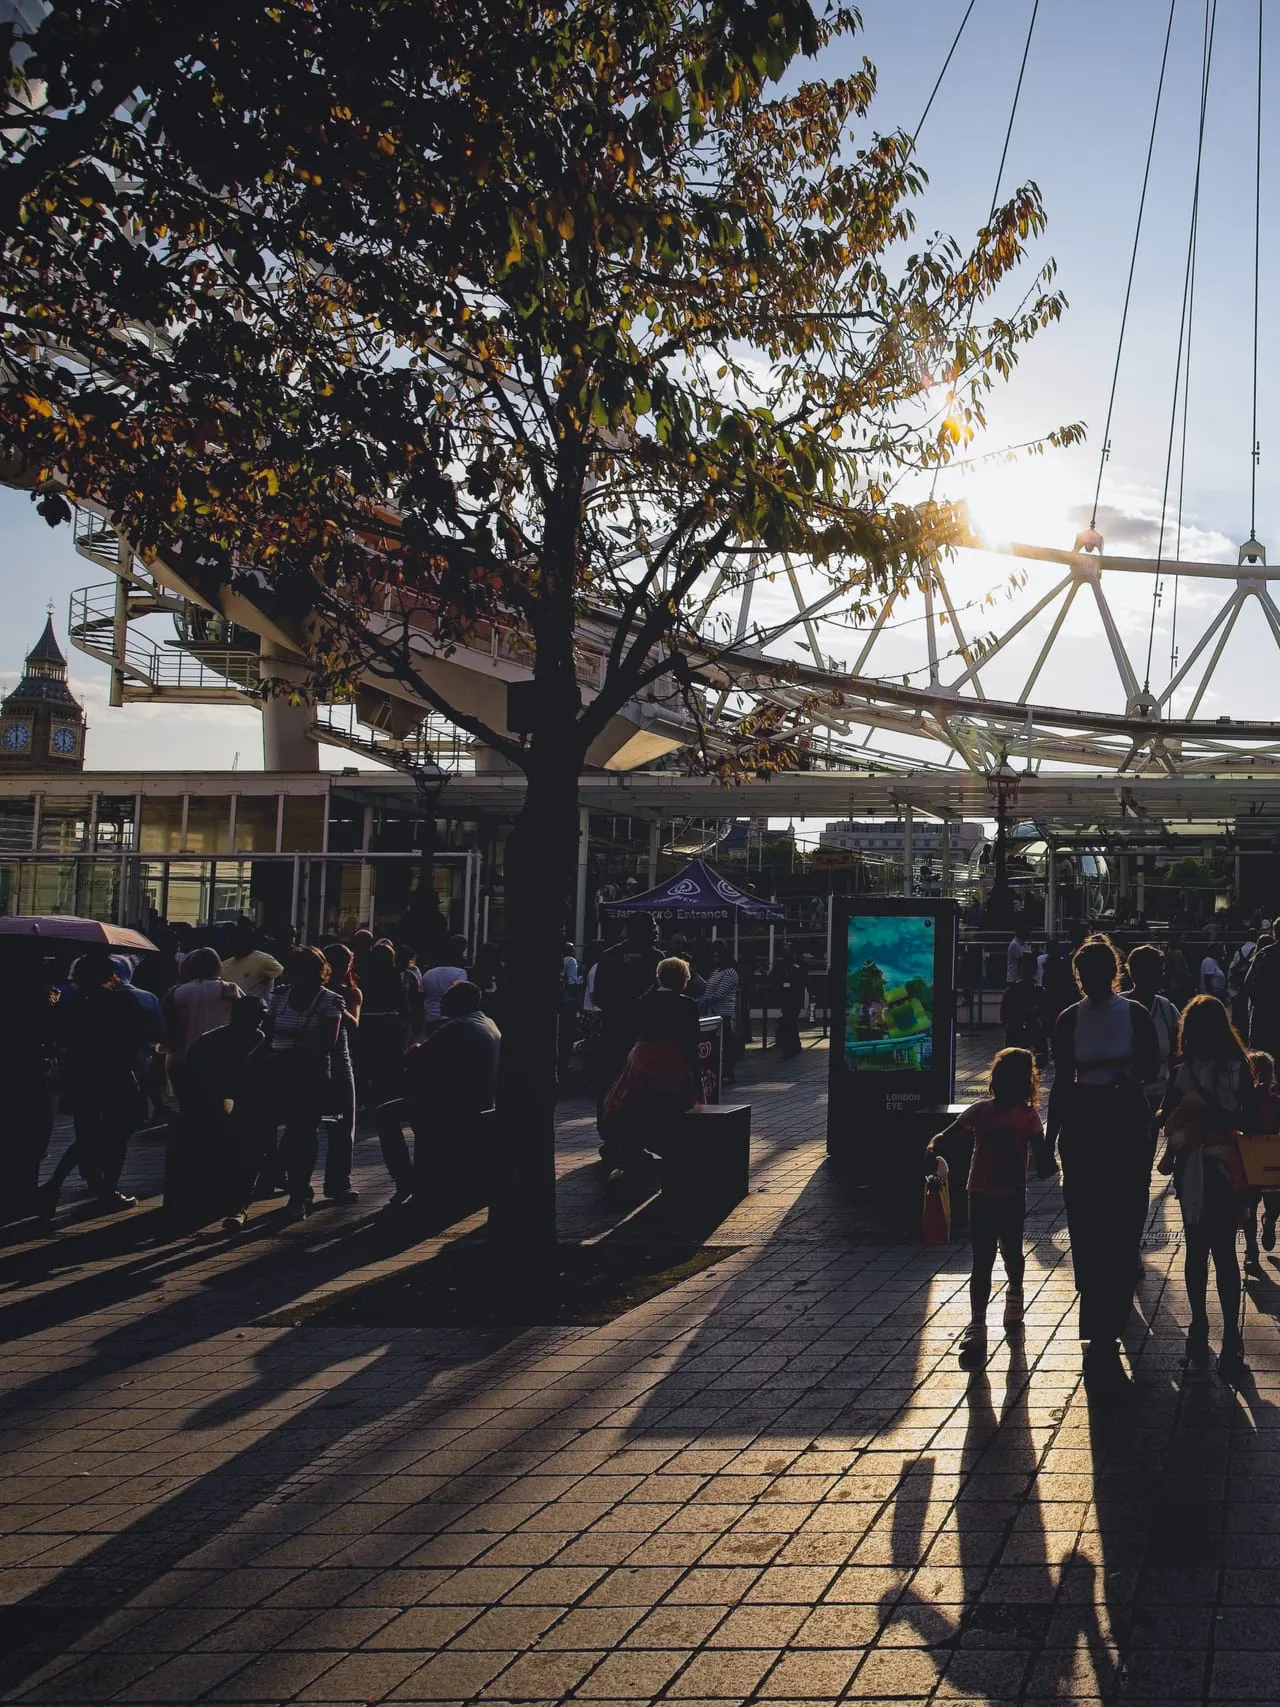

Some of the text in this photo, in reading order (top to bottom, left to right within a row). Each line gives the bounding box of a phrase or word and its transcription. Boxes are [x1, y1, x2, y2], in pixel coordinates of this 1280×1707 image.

[112, 868, 120, 876] Th
[112, 878, 120, 887] Ey
[677, 908, 729, 920] Entrance
[886, 1103, 903, 1111] EYE
